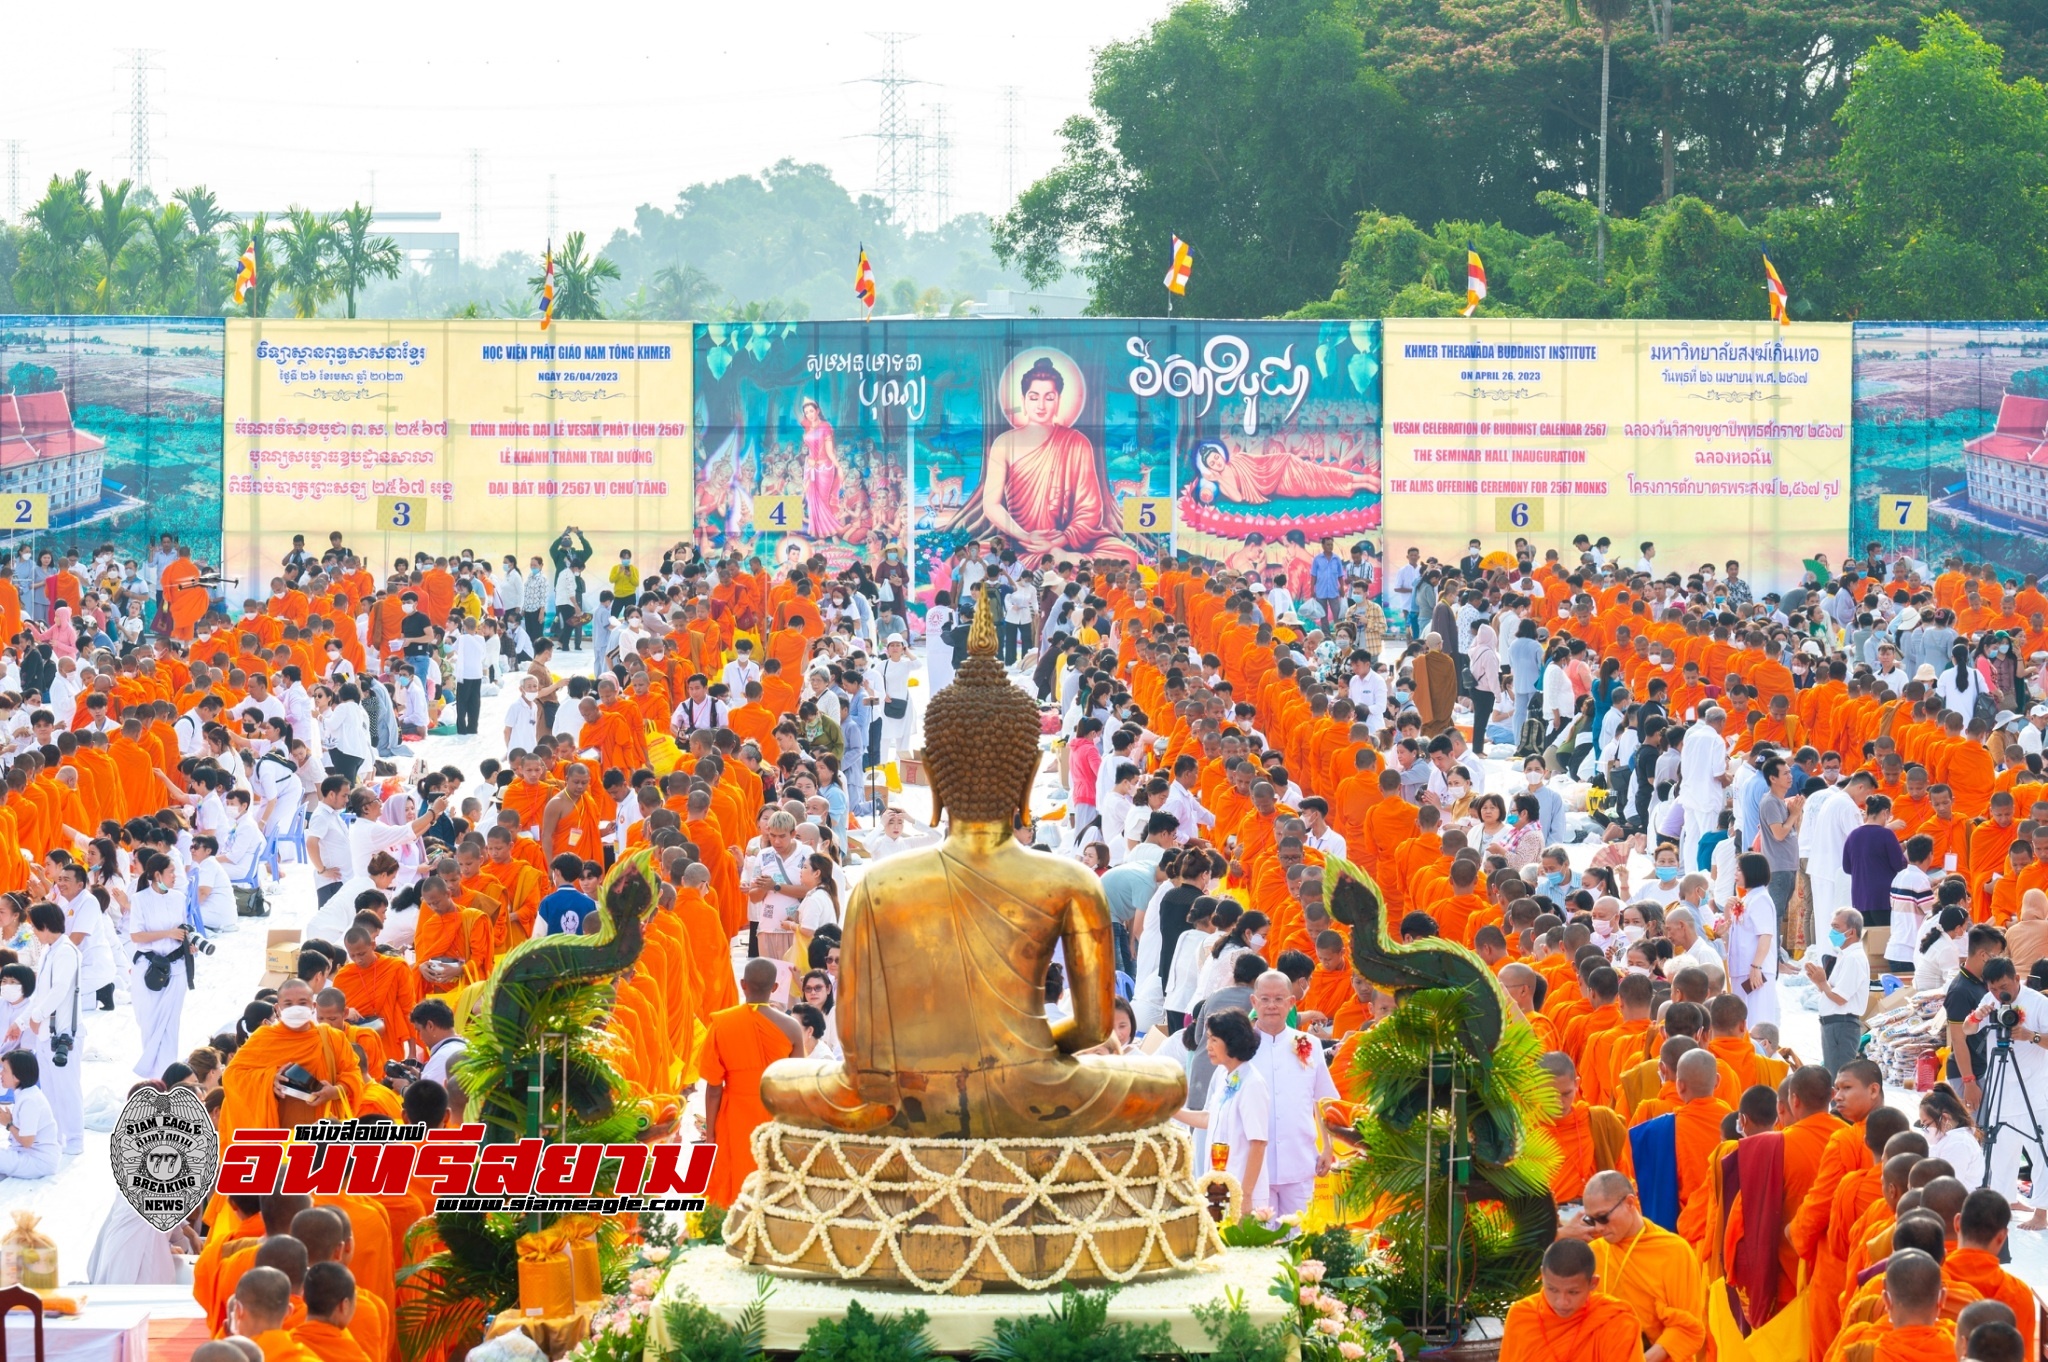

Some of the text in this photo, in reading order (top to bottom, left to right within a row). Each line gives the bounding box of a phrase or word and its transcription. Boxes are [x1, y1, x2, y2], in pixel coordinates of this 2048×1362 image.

[482, 343, 671, 362] HỌC VIỆN PHẬT GIÁO NAM TÔNG KHMER
[1404, 344, 1438, 358] KHMER
[1497, 345, 1546, 359] BUDDHIST
[1549, 346, 1597, 360] INSTITUTE
[1650, 337, 1820, 362] มหาวิทยาลัยสงฆ์เกิ่นเทอ
[300, 371, 317, 381] ២៦
[369, 371, 404, 382] ២០២៣
[538, 370, 618, 382] NGÀY 26/04/2023
[1460, 371, 1473, 380] ON
[1475, 371, 1500, 381] APRIL
[1518, 372, 1541, 381] 2023
[1661, 367, 1697, 386] วันพุธที่
[1699, 371, 1713, 383] ๒๖
[1715, 372, 1752, 383] เมษายน
[1755, 373, 1777, 384] พ.ศ.
[394, 420, 448, 436] ២៥៦៧
[470, 422, 496, 436] KÍNH
[553, 419, 565, 436] LỄ
[567, 423, 601, 436] VESAK
[602, 421, 630, 439] PHẬT
[632, 423, 656, 439] LỊCH
[658, 423, 685, 436] 2567
[1393, 422, 1607, 436] VESAK CELEBRATION OF BUDDHIST CALENDAR 2567
[1624, 420, 1844, 442] ฉลองวันวิสาขบูชาปีพุทธศักราช ๒๕๖๗
[500, 447, 511, 464] LỄ
[514, 448, 549, 464] KHÁNH
[552, 448, 587, 464] THÀNH
[591, 451, 614, 464] TRAI
[1413, 449, 1586, 463] THE SEMINAR HALL INAUGURATION
[1695, 447, 1772, 465] ฉลองหอฉัน
[372, 477, 425, 494] ២៥៦៧
[512, 480, 534, 495] BÁT
[538, 480, 558, 497] HỘI
[561, 482, 591, 495] 2567
[593, 482, 606, 497] VỊ
[609, 480, 635, 495] CHƯ
[637, 479, 667, 495] TĂNG
[1390, 480, 1608, 494] THE ALMS OFFERING CEREMONY FOR 2567 MONKS
[1627, 473, 1779, 495] โครงการตักบาตรพระสงฆ์
[1823, 479, 1840, 500] รูป
[15, 499, 33, 523] 2
[392, 502, 411, 526] 3
[769, 501, 787, 526] 4
[1139, 503, 1157, 527] 5
[1511, 502, 1529, 527] 6
[1895, 501, 1912, 525] 7
